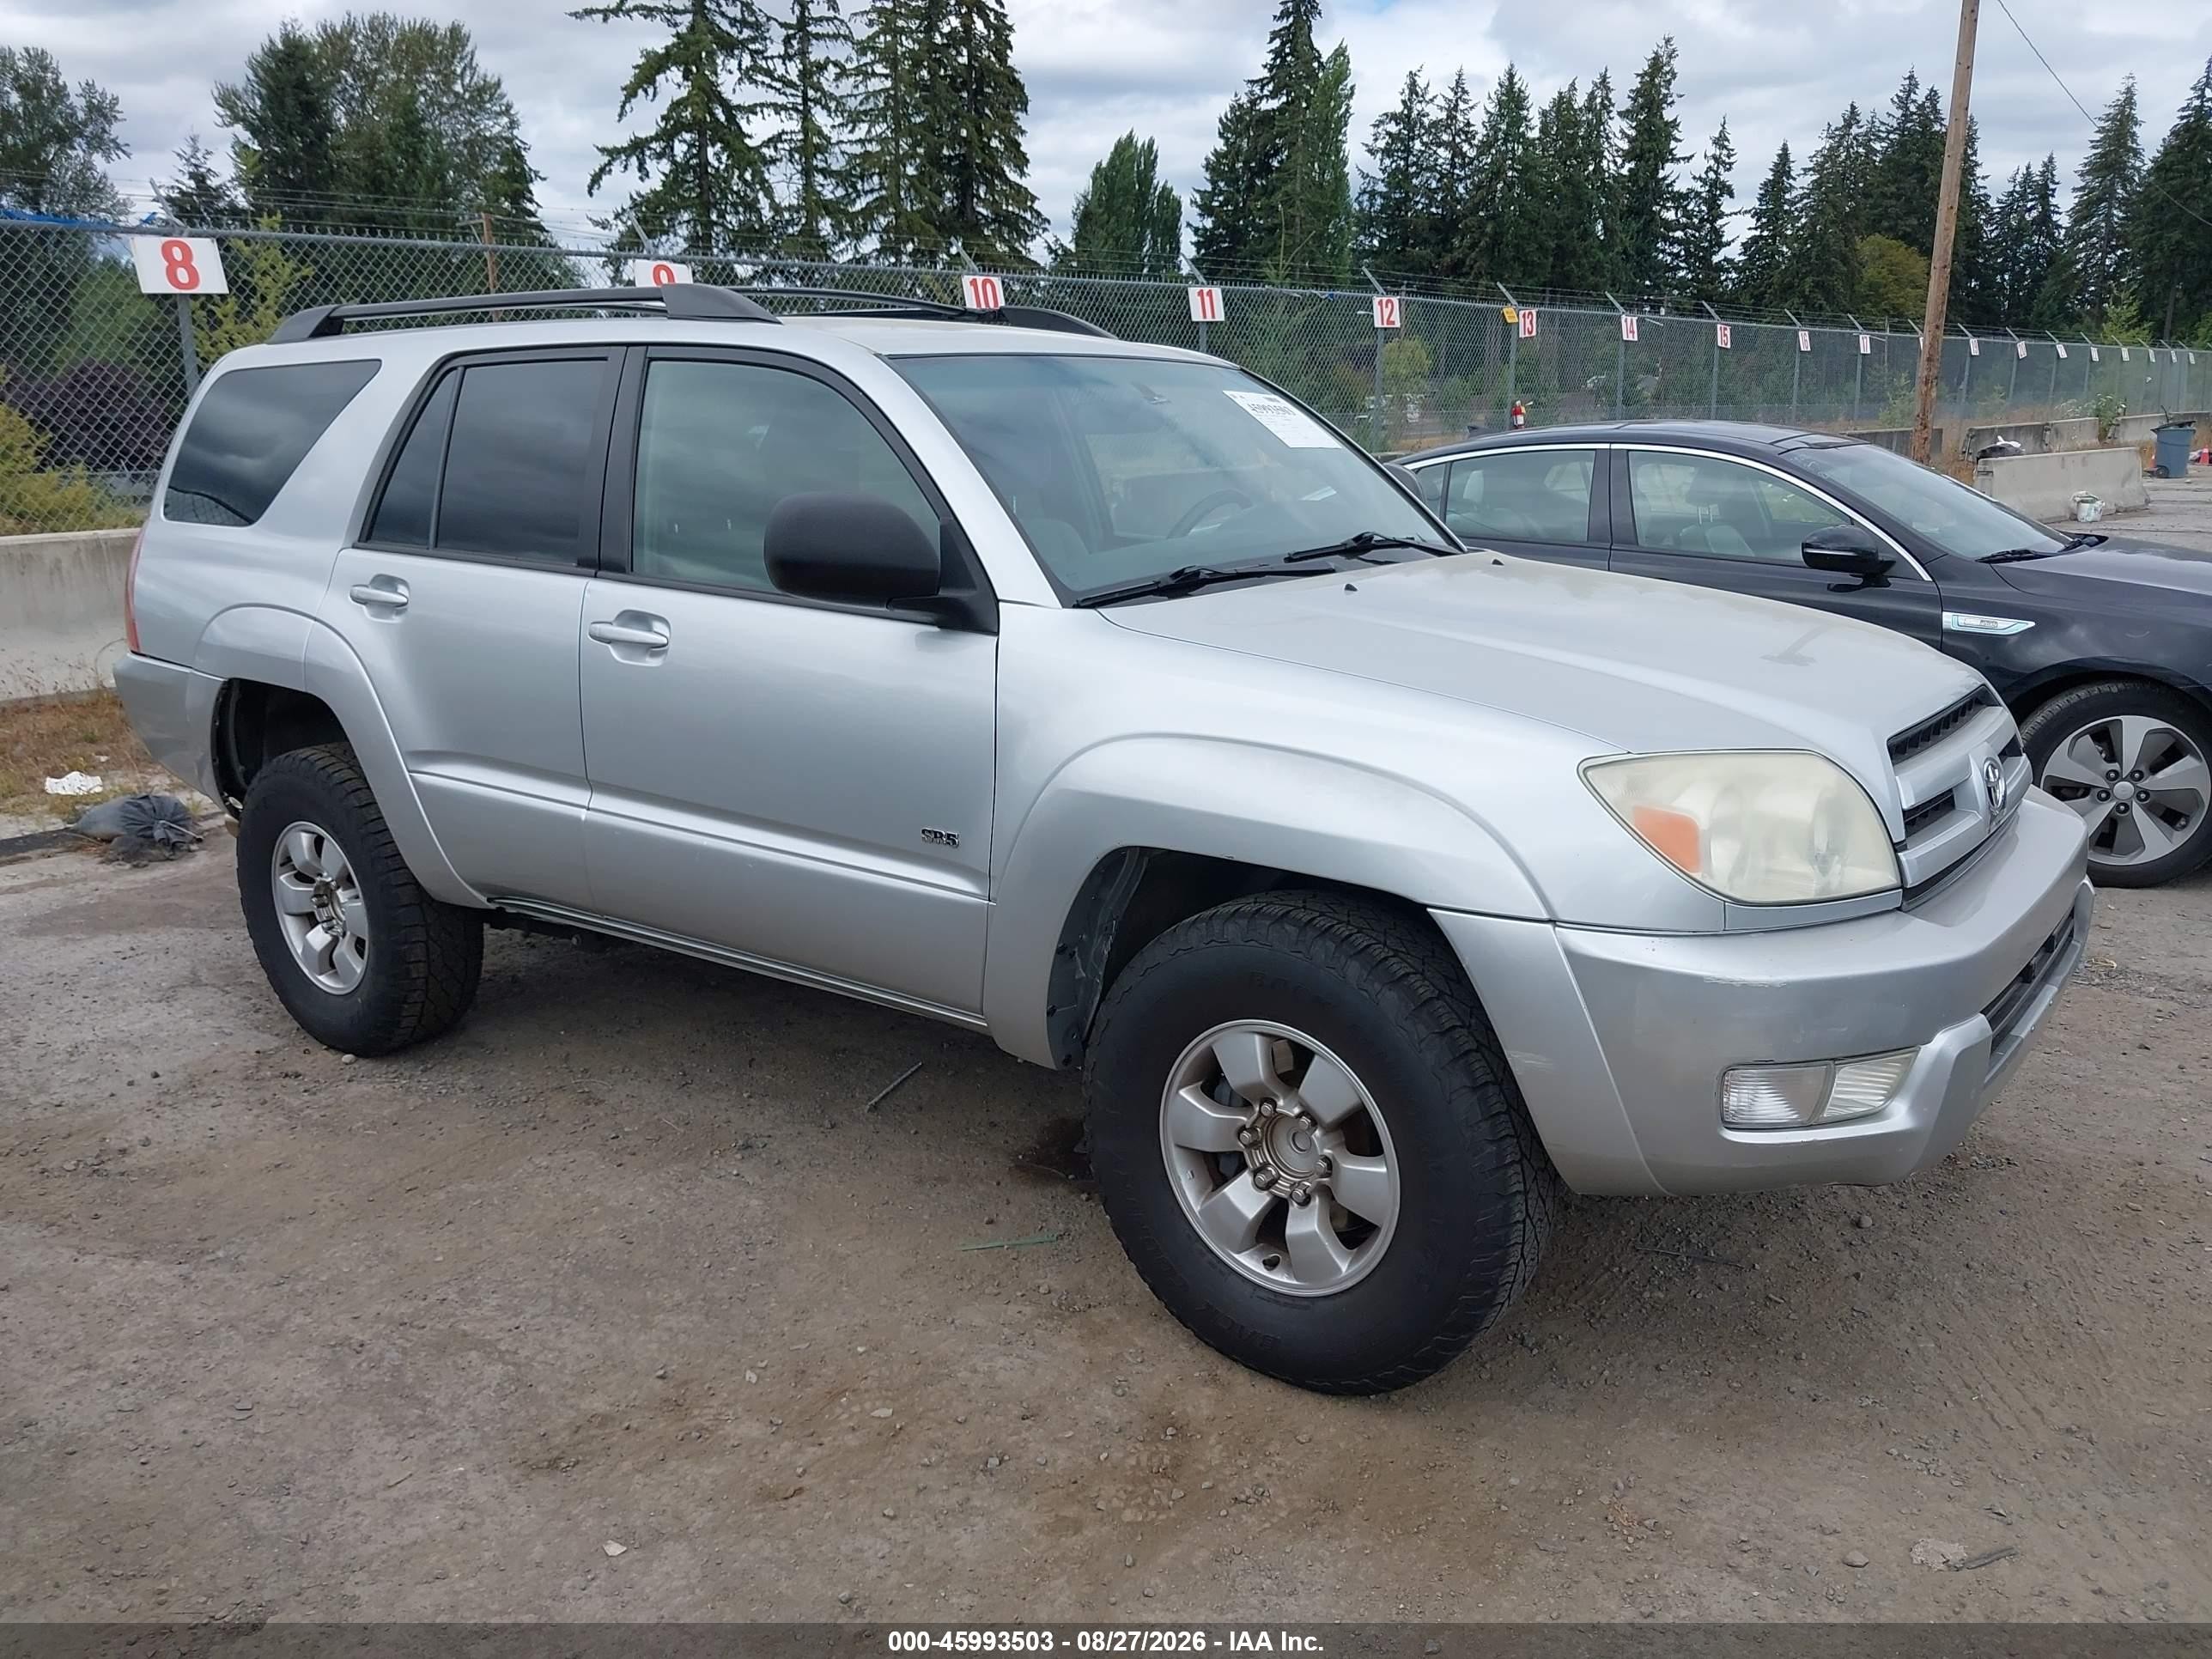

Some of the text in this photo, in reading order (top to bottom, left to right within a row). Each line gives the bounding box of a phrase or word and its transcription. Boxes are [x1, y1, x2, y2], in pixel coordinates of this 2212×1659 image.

[161, 239, 201, 292] 8
[969, 276, 1000, 309] 10
[1197, 289, 1216, 319] 11
[1377, 298, 1395, 326] 12
[1522, 310, 1534, 337] 13
[1625, 317, 1636, 339] 14
[1719, 325, 1729, 346] 15
[1801, 332, 1809, 349] 16
[1862, 335, 1869, 352] 17
[921, 827, 959, 848] SR5
